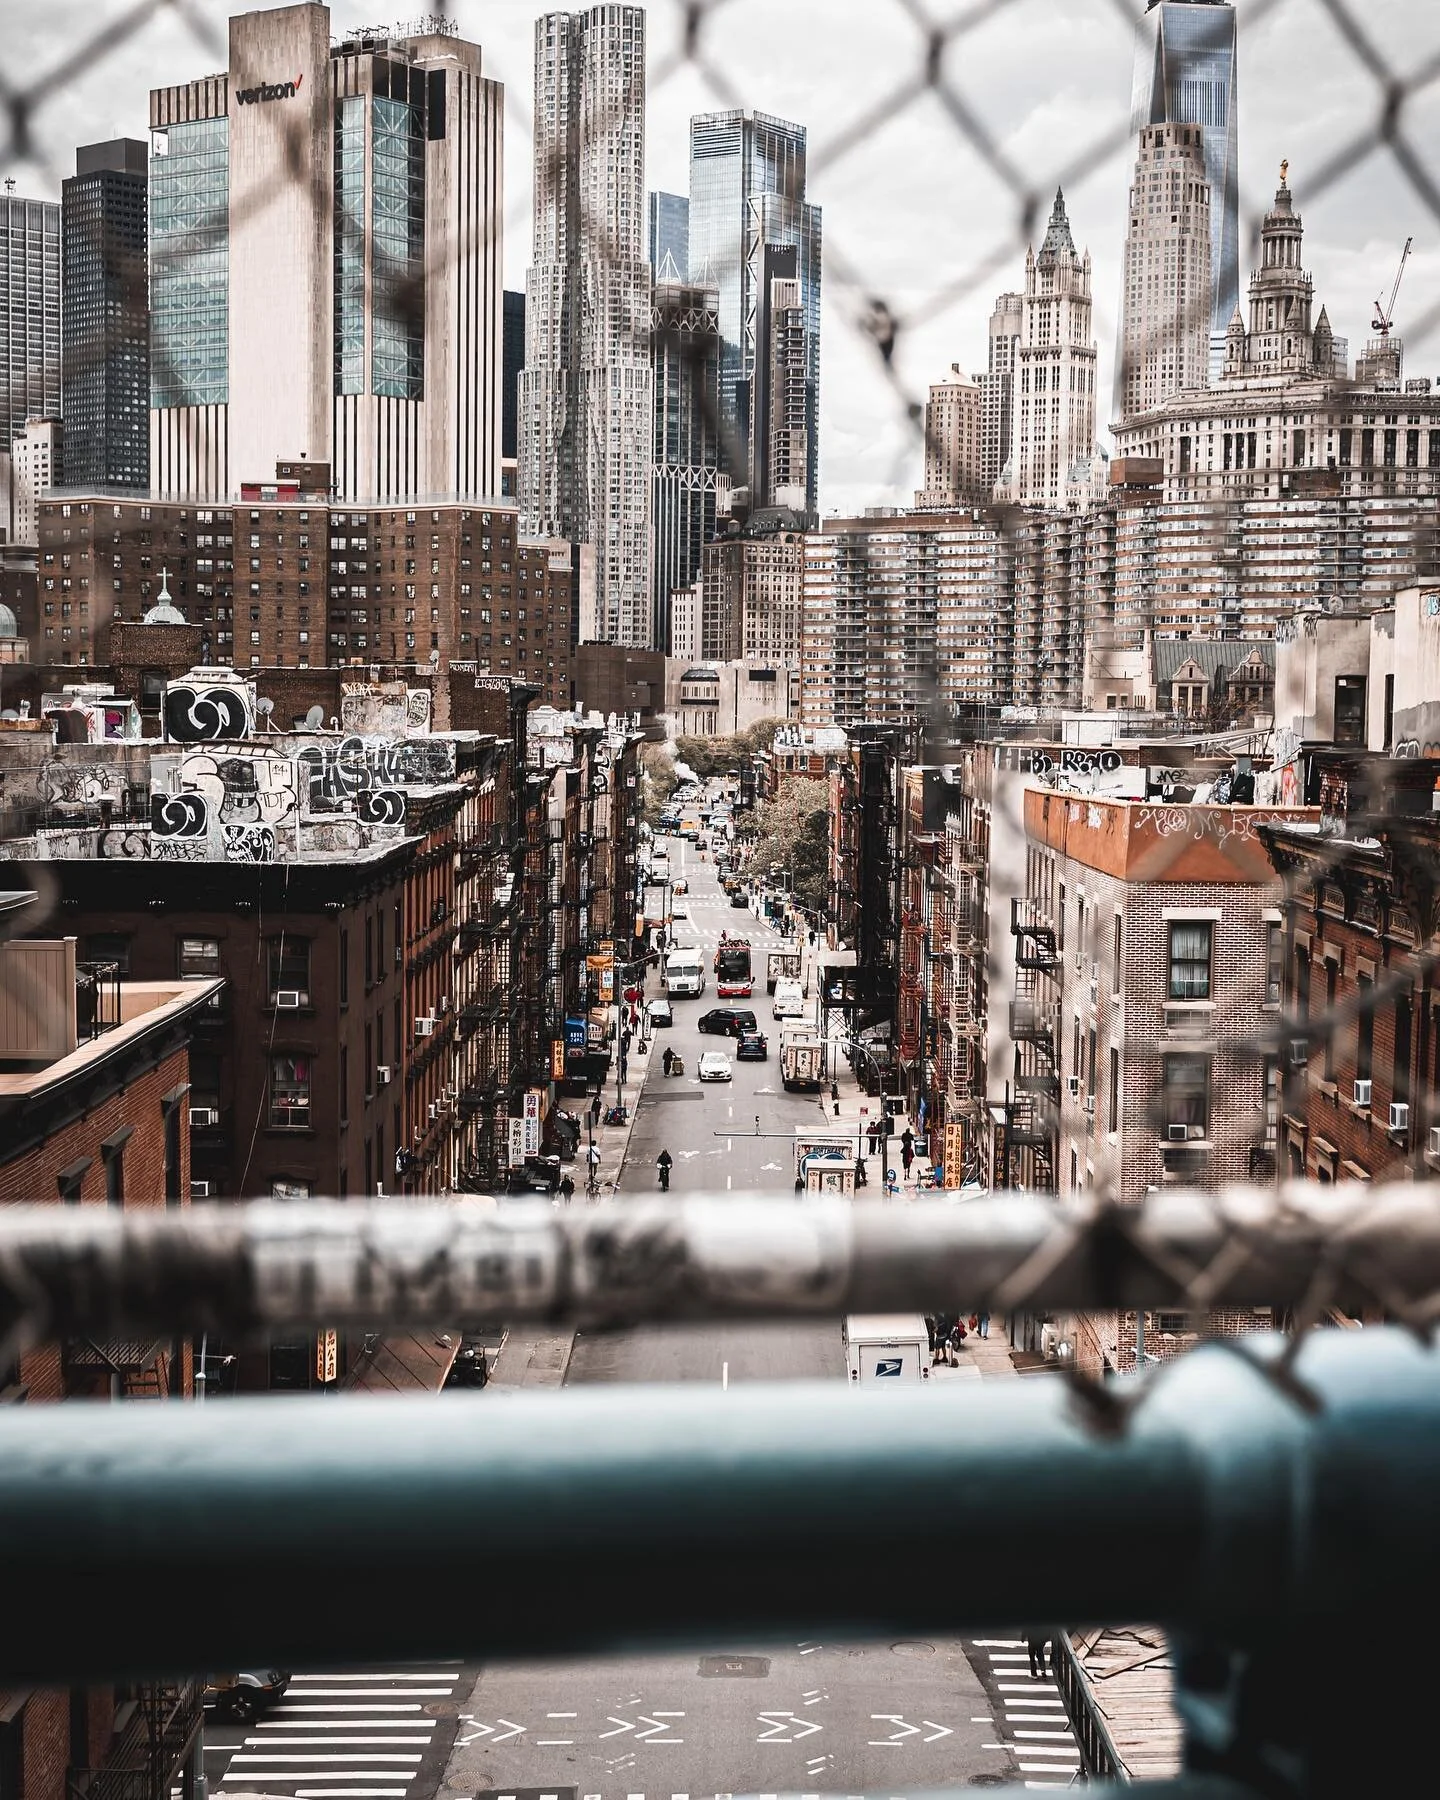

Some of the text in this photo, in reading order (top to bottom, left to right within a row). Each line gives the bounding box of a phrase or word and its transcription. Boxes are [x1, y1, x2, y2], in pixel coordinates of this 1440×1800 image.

[236, 81, 295, 106] verizon
[946, 1126, 954, 1187] 日月洗衣店
